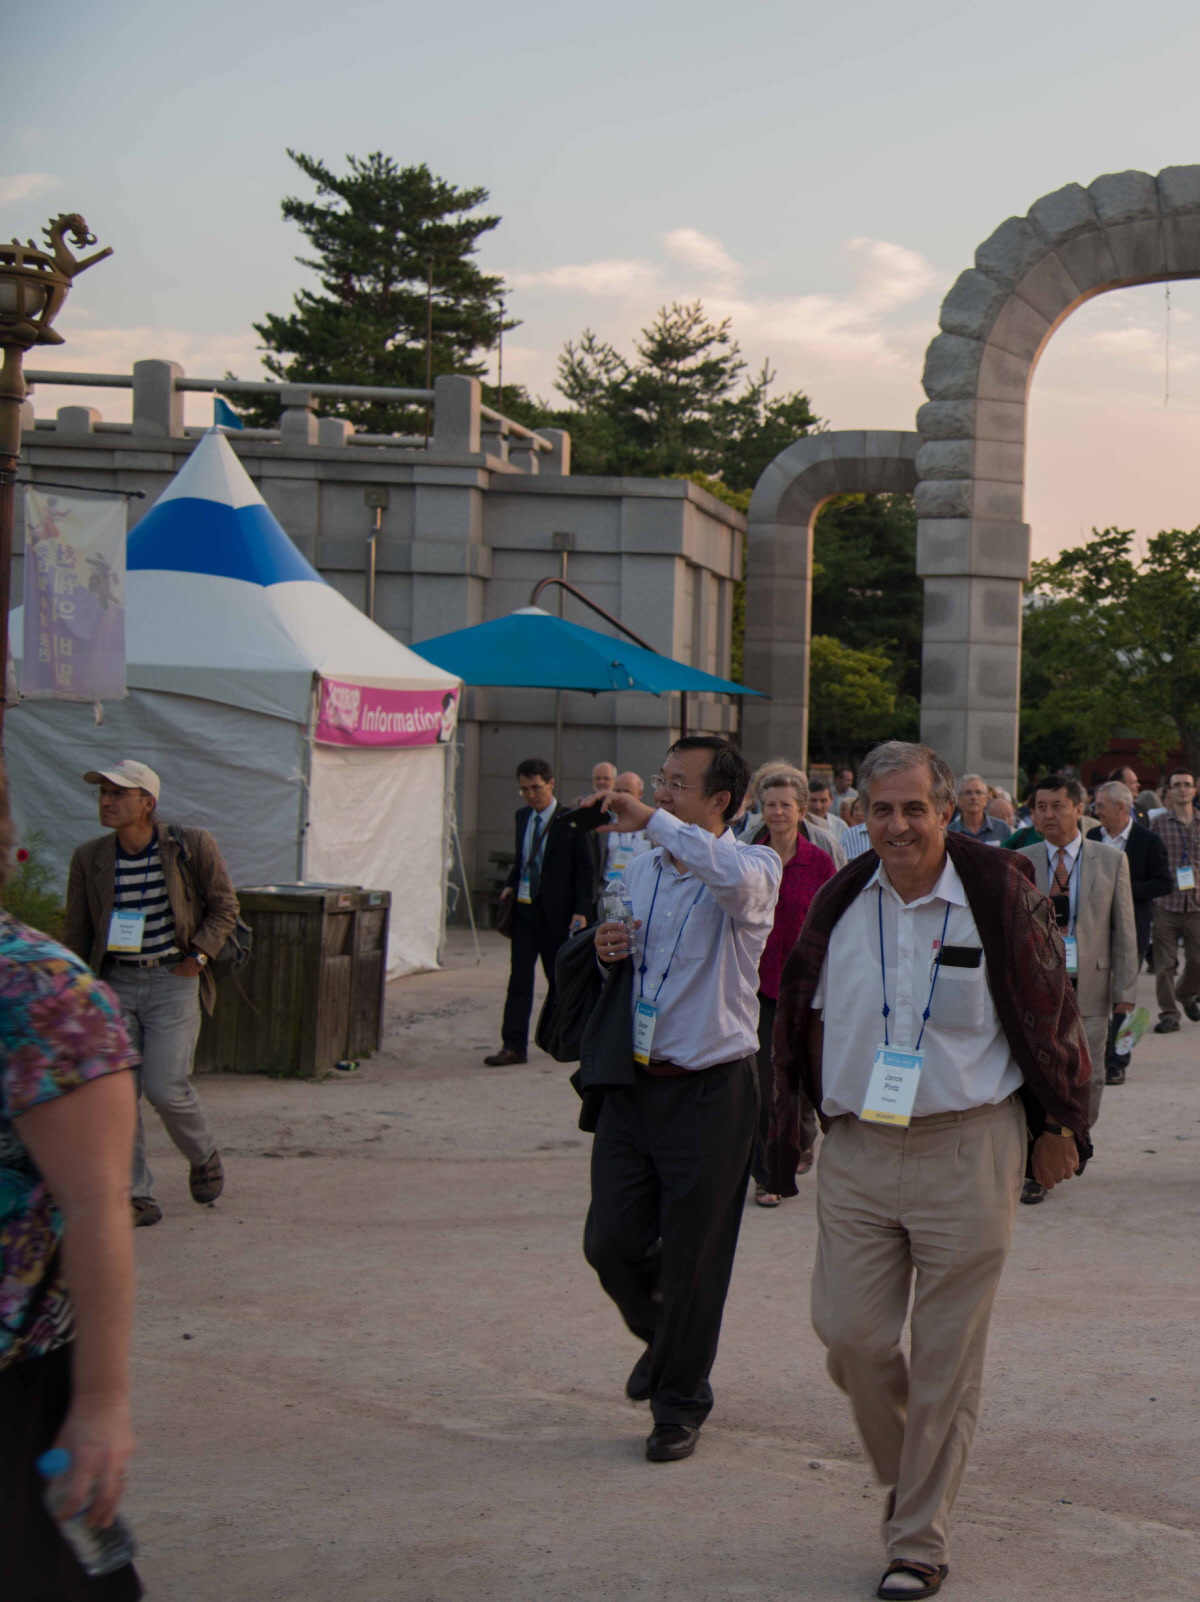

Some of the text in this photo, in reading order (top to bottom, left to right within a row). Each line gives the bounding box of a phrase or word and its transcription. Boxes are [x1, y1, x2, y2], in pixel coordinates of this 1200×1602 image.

[362, 704, 443, 732] Information
[884, 1073, 903, 1082] Janos
[884, 1083, 900, 1092] Pintz
[881, 1096, 897, 1104] Hungary
[875, 1112, 894, 1120] DELEGATE
